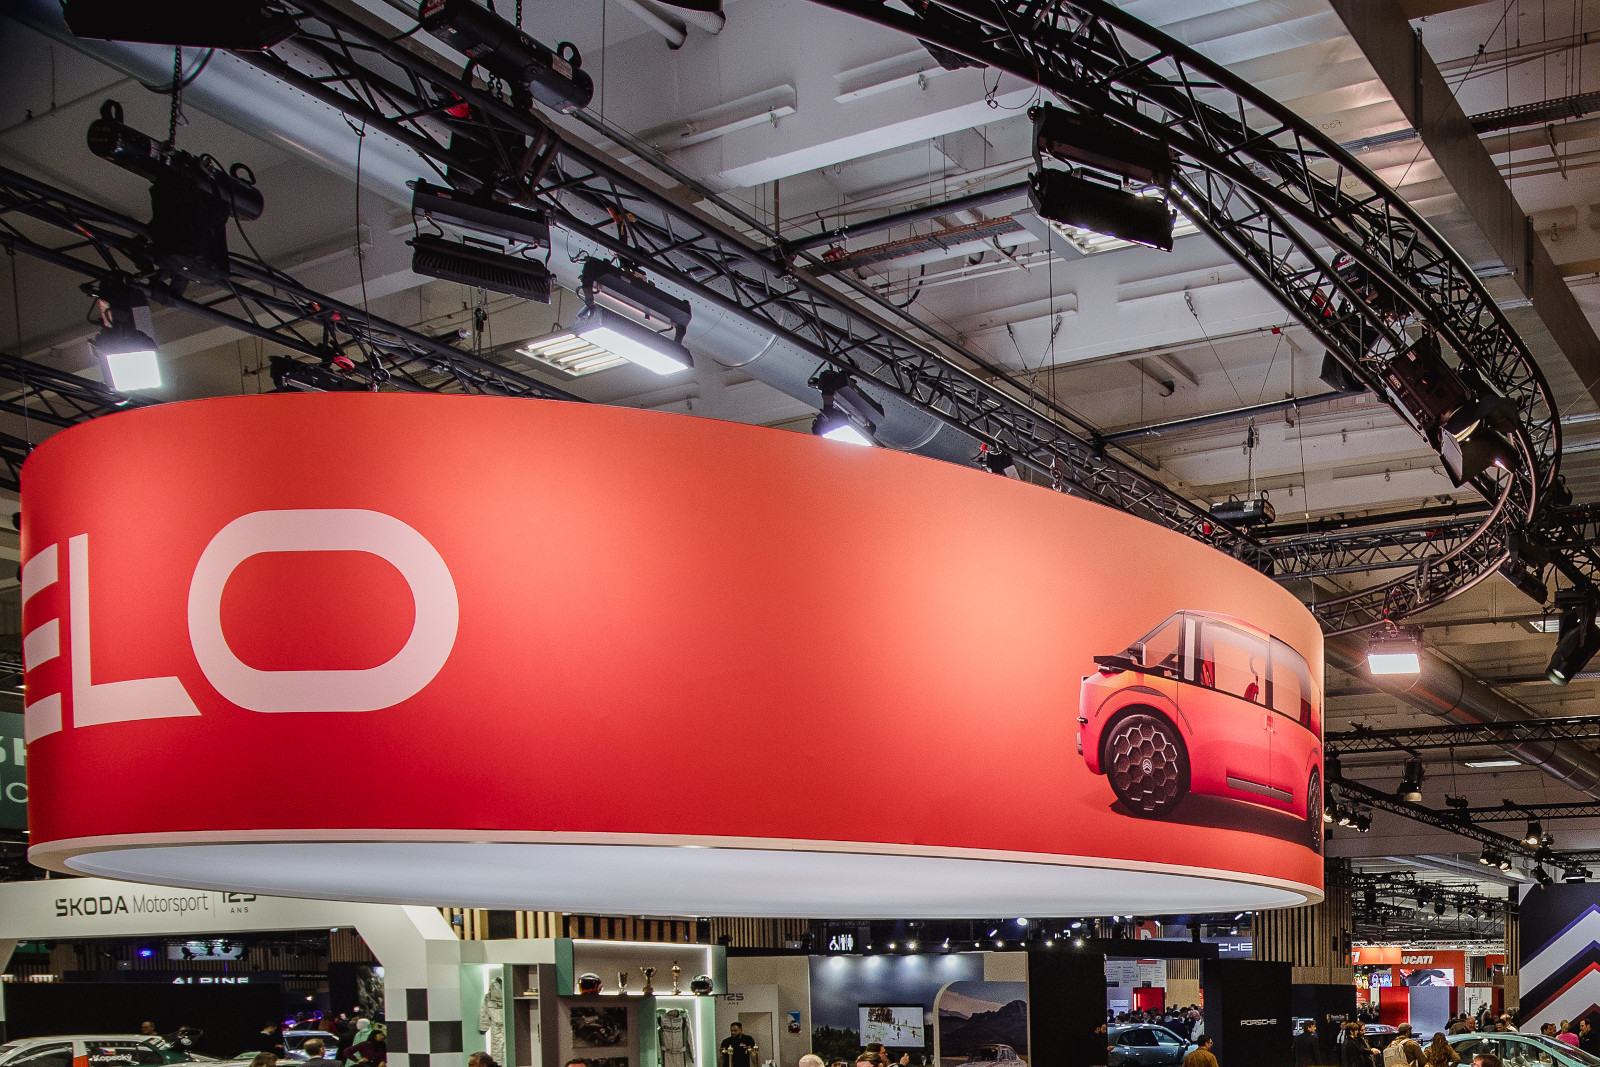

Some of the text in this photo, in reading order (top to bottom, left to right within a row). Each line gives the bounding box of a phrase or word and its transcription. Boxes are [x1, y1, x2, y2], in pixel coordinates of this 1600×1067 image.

[21, 508, 460, 746] ELO
[132, 893, 209, 917] Motorsport
[1401, 955, 1434, 965] UCATI
[1240, 1018, 1277, 1026] PORSCHE
